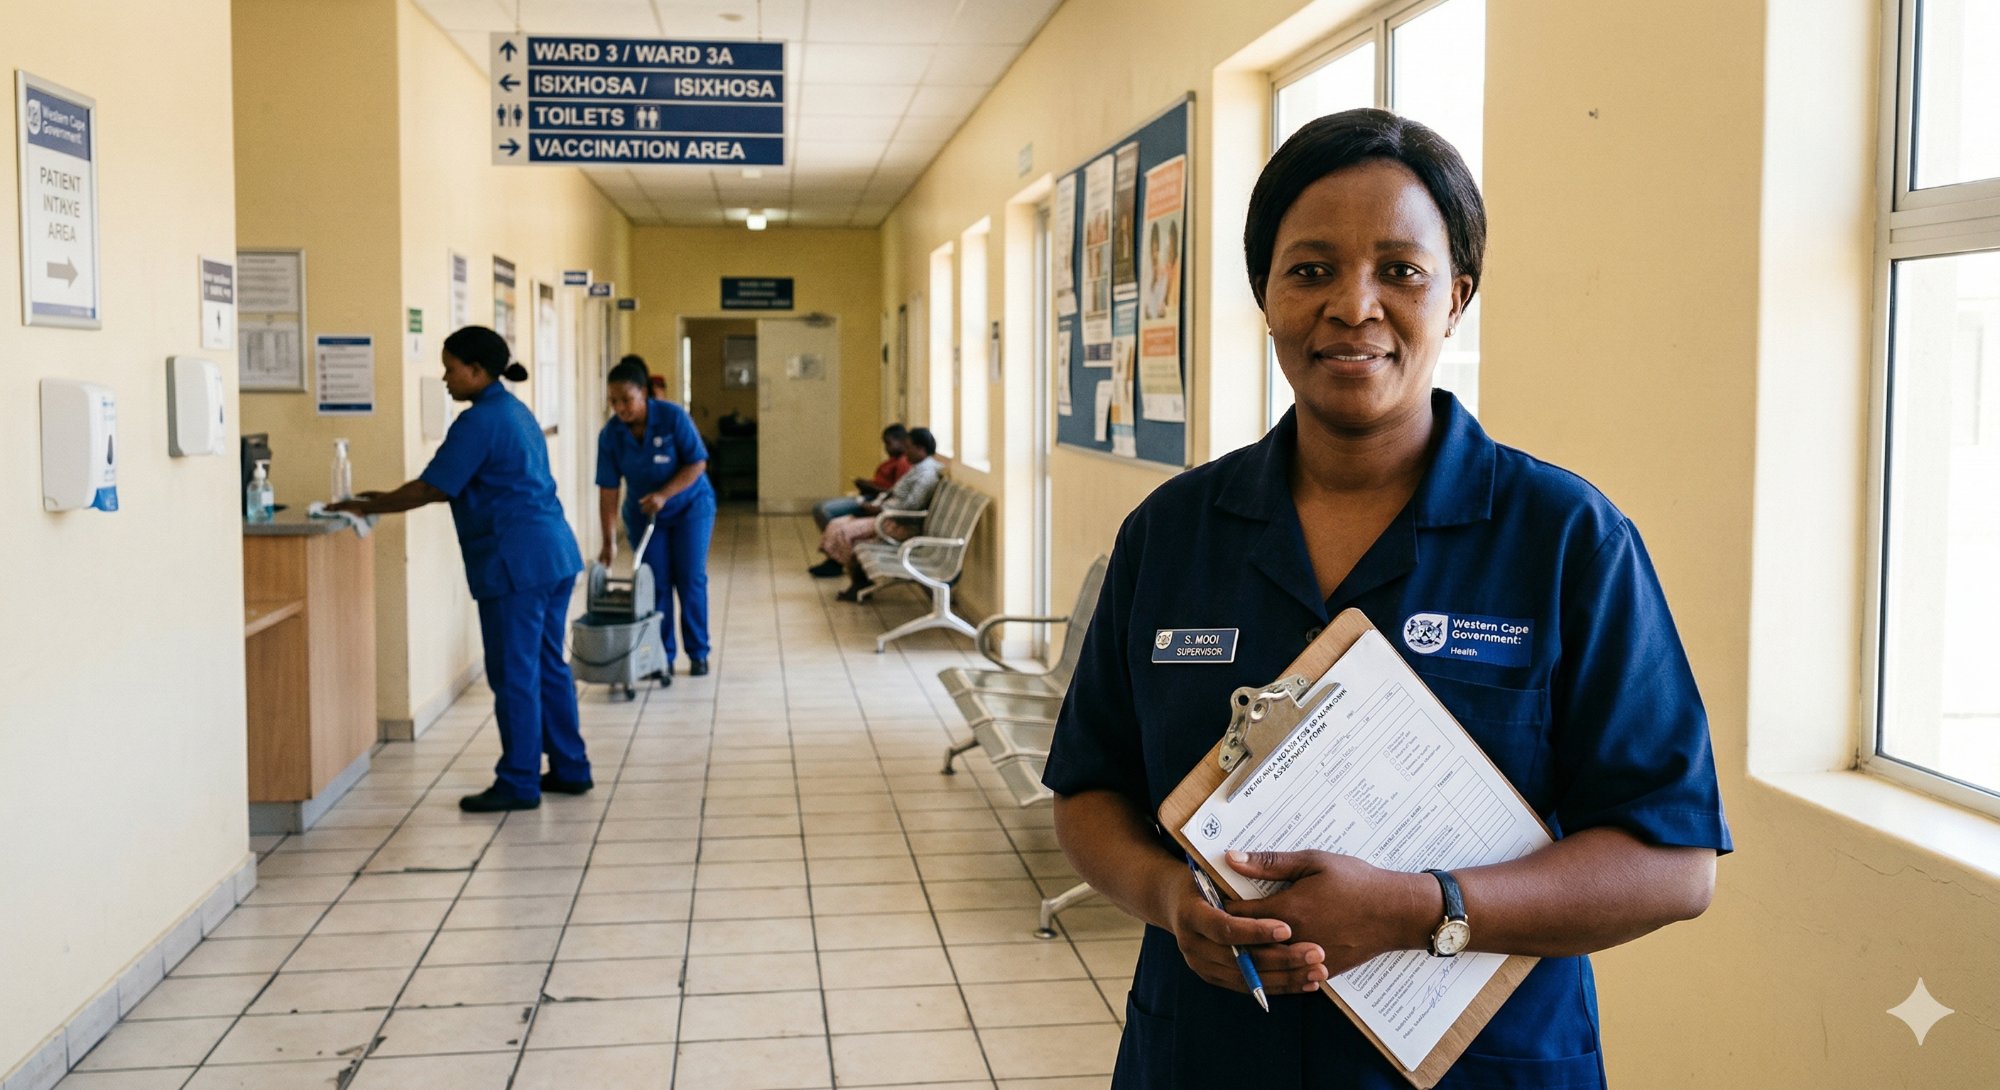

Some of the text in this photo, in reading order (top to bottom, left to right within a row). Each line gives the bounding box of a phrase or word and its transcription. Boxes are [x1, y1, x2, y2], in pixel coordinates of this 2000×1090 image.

[533, 43, 734, 65] WARD 3 / WARD 3A
[534, 74, 776, 98] ISIXHOSA / ISIXHOSA
[535, 106, 625, 126] TOILETS
[535, 138, 746, 160] VACCINATION AREA
[40, 166, 81, 193] PATIENT
[48, 221, 77, 242] AREA
[1452, 619, 1529, 635] Western Cape
[1452, 629, 1522, 645] Government:
[1184, 634, 1220, 645] S. MOOI
[1176, 647, 1223, 656] SUPERVISOR
[1450, 647, 1478, 657] Health
